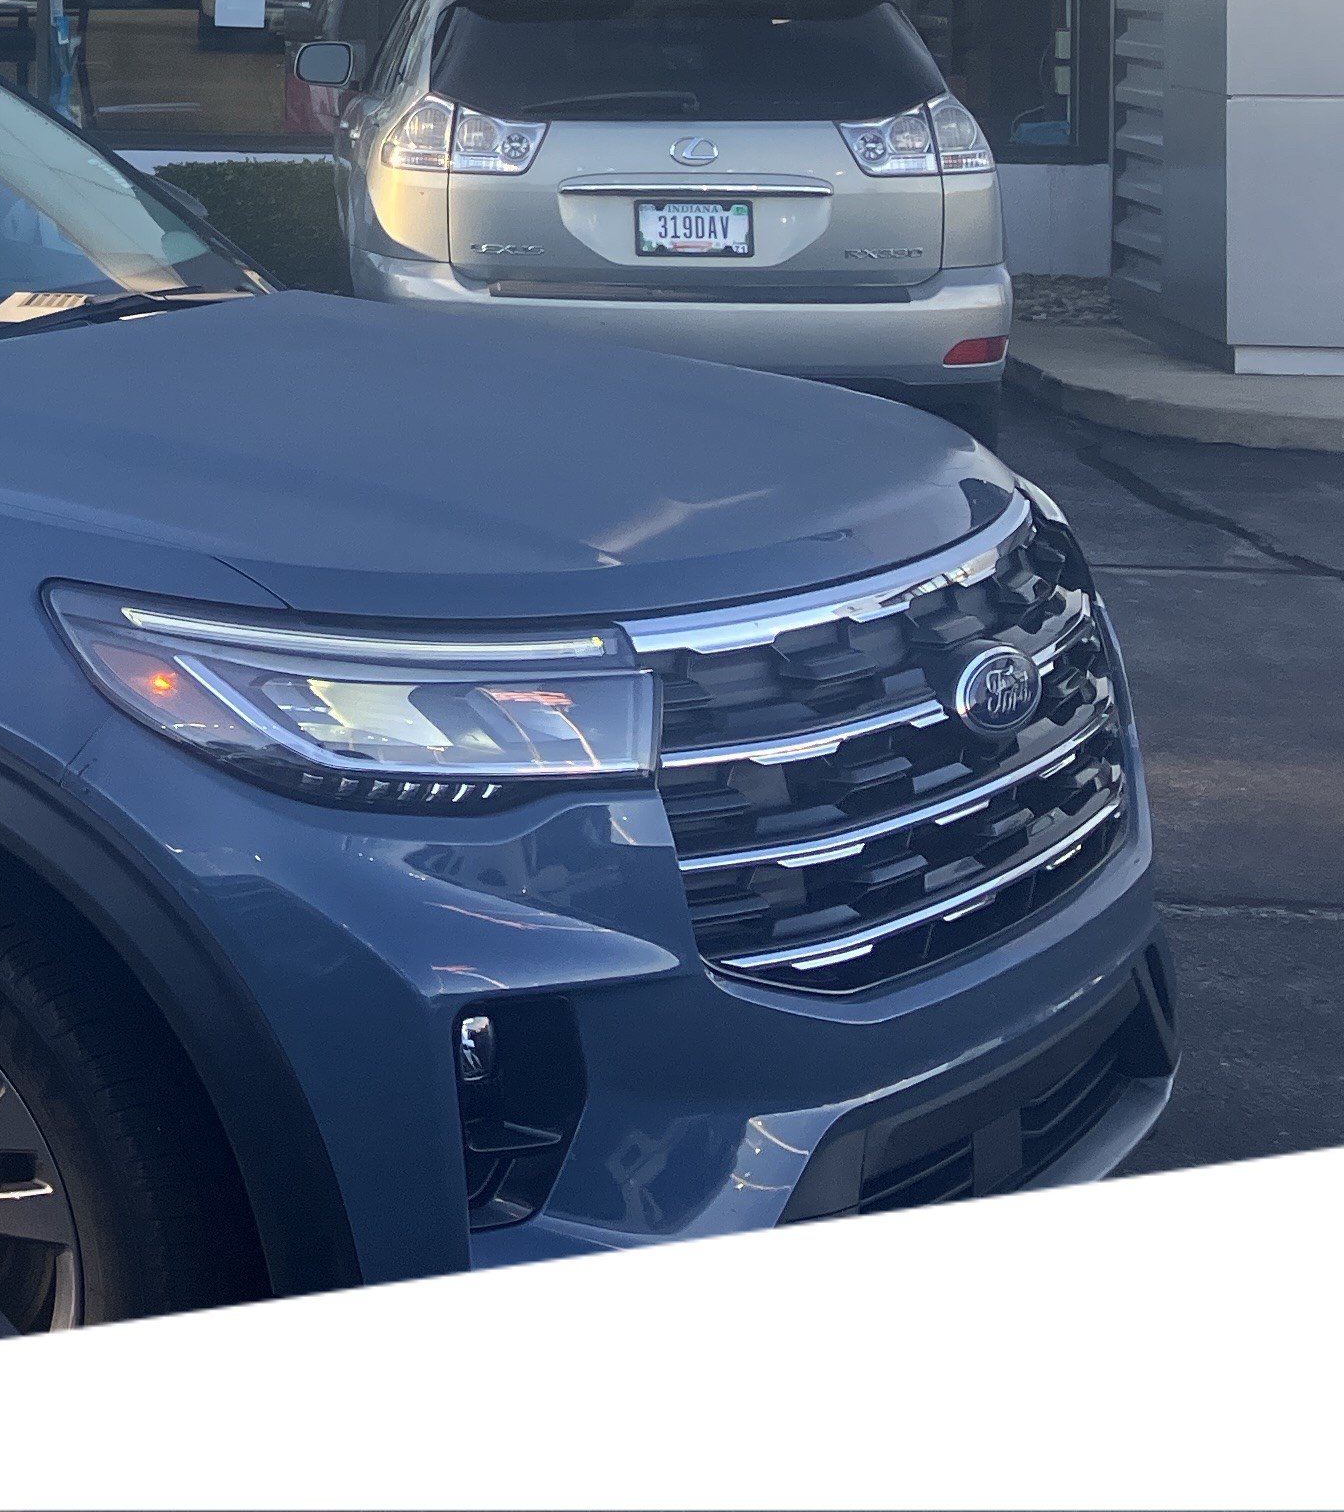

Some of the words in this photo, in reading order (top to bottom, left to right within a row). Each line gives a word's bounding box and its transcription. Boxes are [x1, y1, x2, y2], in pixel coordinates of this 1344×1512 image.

[666, 205, 720, 214] INDIANA
[657, 215, 730, 240] 319DAV
[985, 664, 1033, 714] Ford
